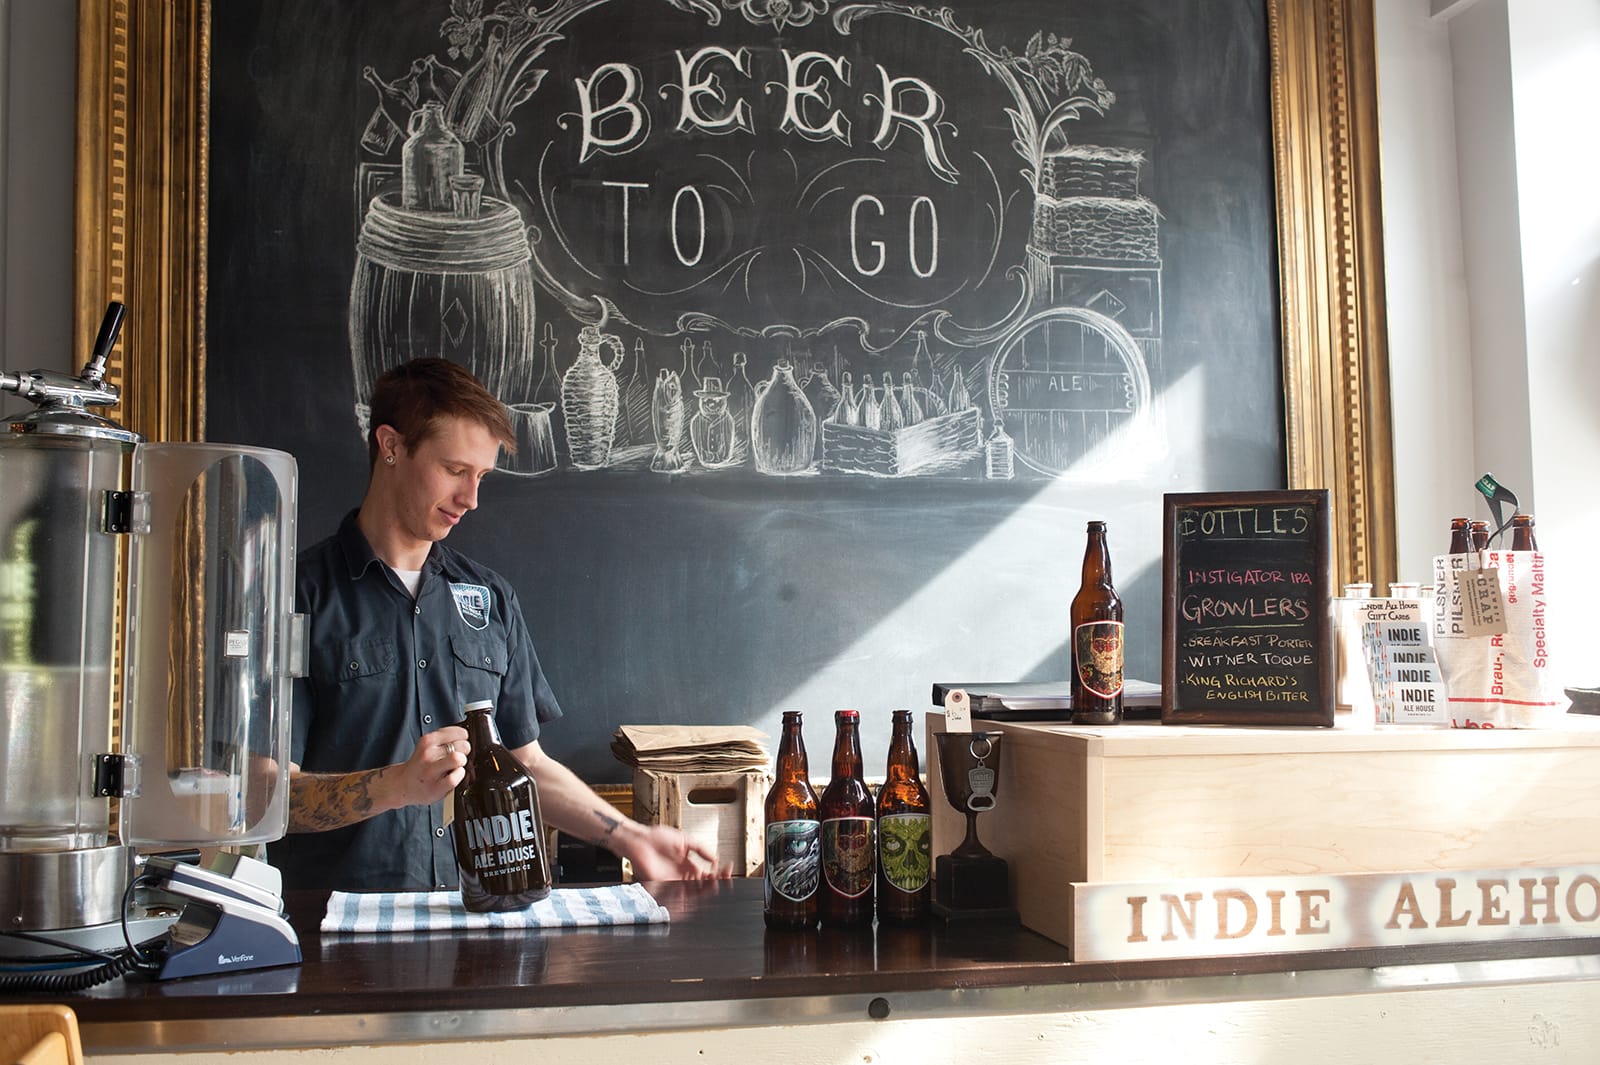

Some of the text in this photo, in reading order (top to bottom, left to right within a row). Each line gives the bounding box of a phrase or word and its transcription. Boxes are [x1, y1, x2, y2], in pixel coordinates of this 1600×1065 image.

[558, 46, 960, 184] BEER
[602, 180, 939, 278] TO GO
[1048, 375, 1083, 392] ALE
[1181, 507, 1309, 536] BOTTLES
[1189, 569, 1313, 585] INSTIGATOR IPA
[1436, 559, 1447, 634] PILSNER
[1476, 578, 1494, 624] CRAP
[1182, 594, 1311, 624] GROWLERS
[1265, 634, 1314, 649] PORTER
[1388, 628, 1422, 641] INDIE
[1532, 600, 1548, 668] Specialty
[1260, 652, 1314, 667] TOQUE
[1185, 673, 1221, 688] KING
[1397, 669, 1432, 682] INDIE
[1205, 689, 1310, 702] ENGLISH BITTER
[1401, 689, 1436, 703] INDIE
[465, 809, 535, 850] INDIE
[475, 844, 536, 869] ALE HOUSE
[483, 866, 521, 878] BREWING
[1126, 874, 1600, 943] INDIE ALEHO
